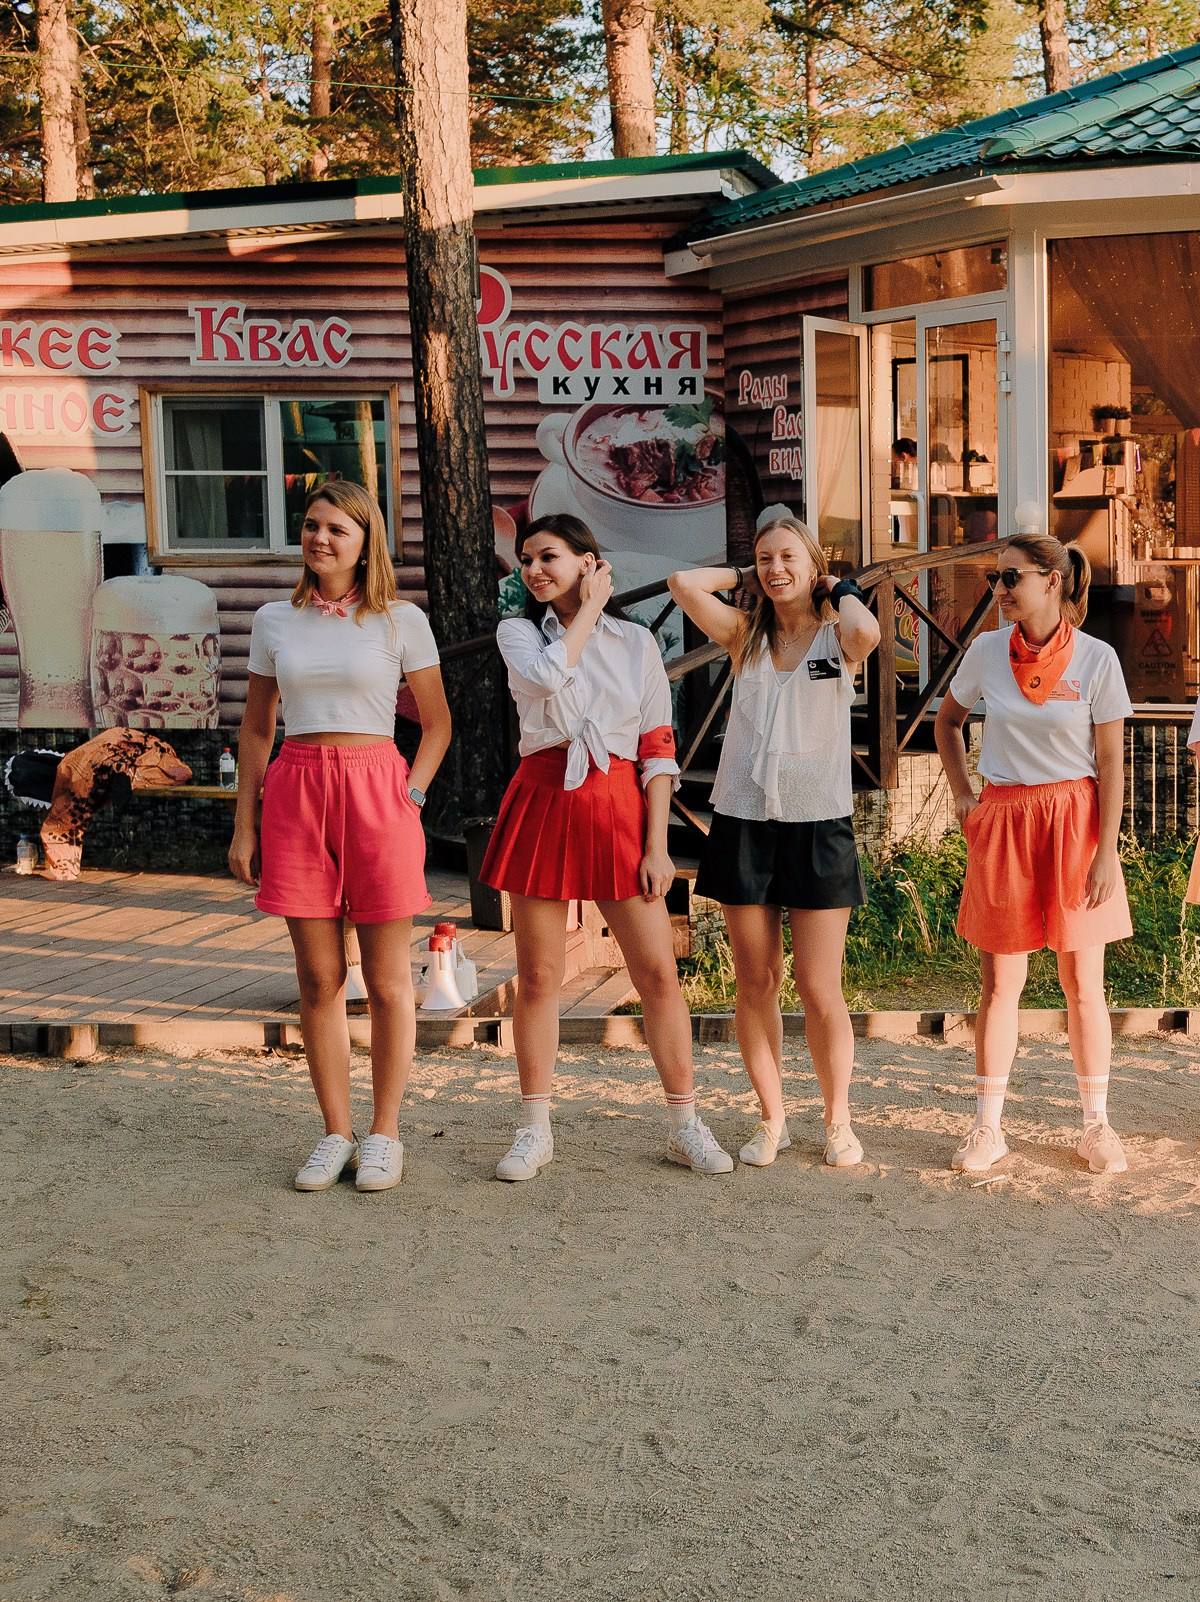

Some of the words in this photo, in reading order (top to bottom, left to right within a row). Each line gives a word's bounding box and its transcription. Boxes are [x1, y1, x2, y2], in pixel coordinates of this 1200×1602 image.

[194, 305, 349, 365] Квас
[552, 375, 697, 402] кухня
[739, 371, 787, 409] Рады
